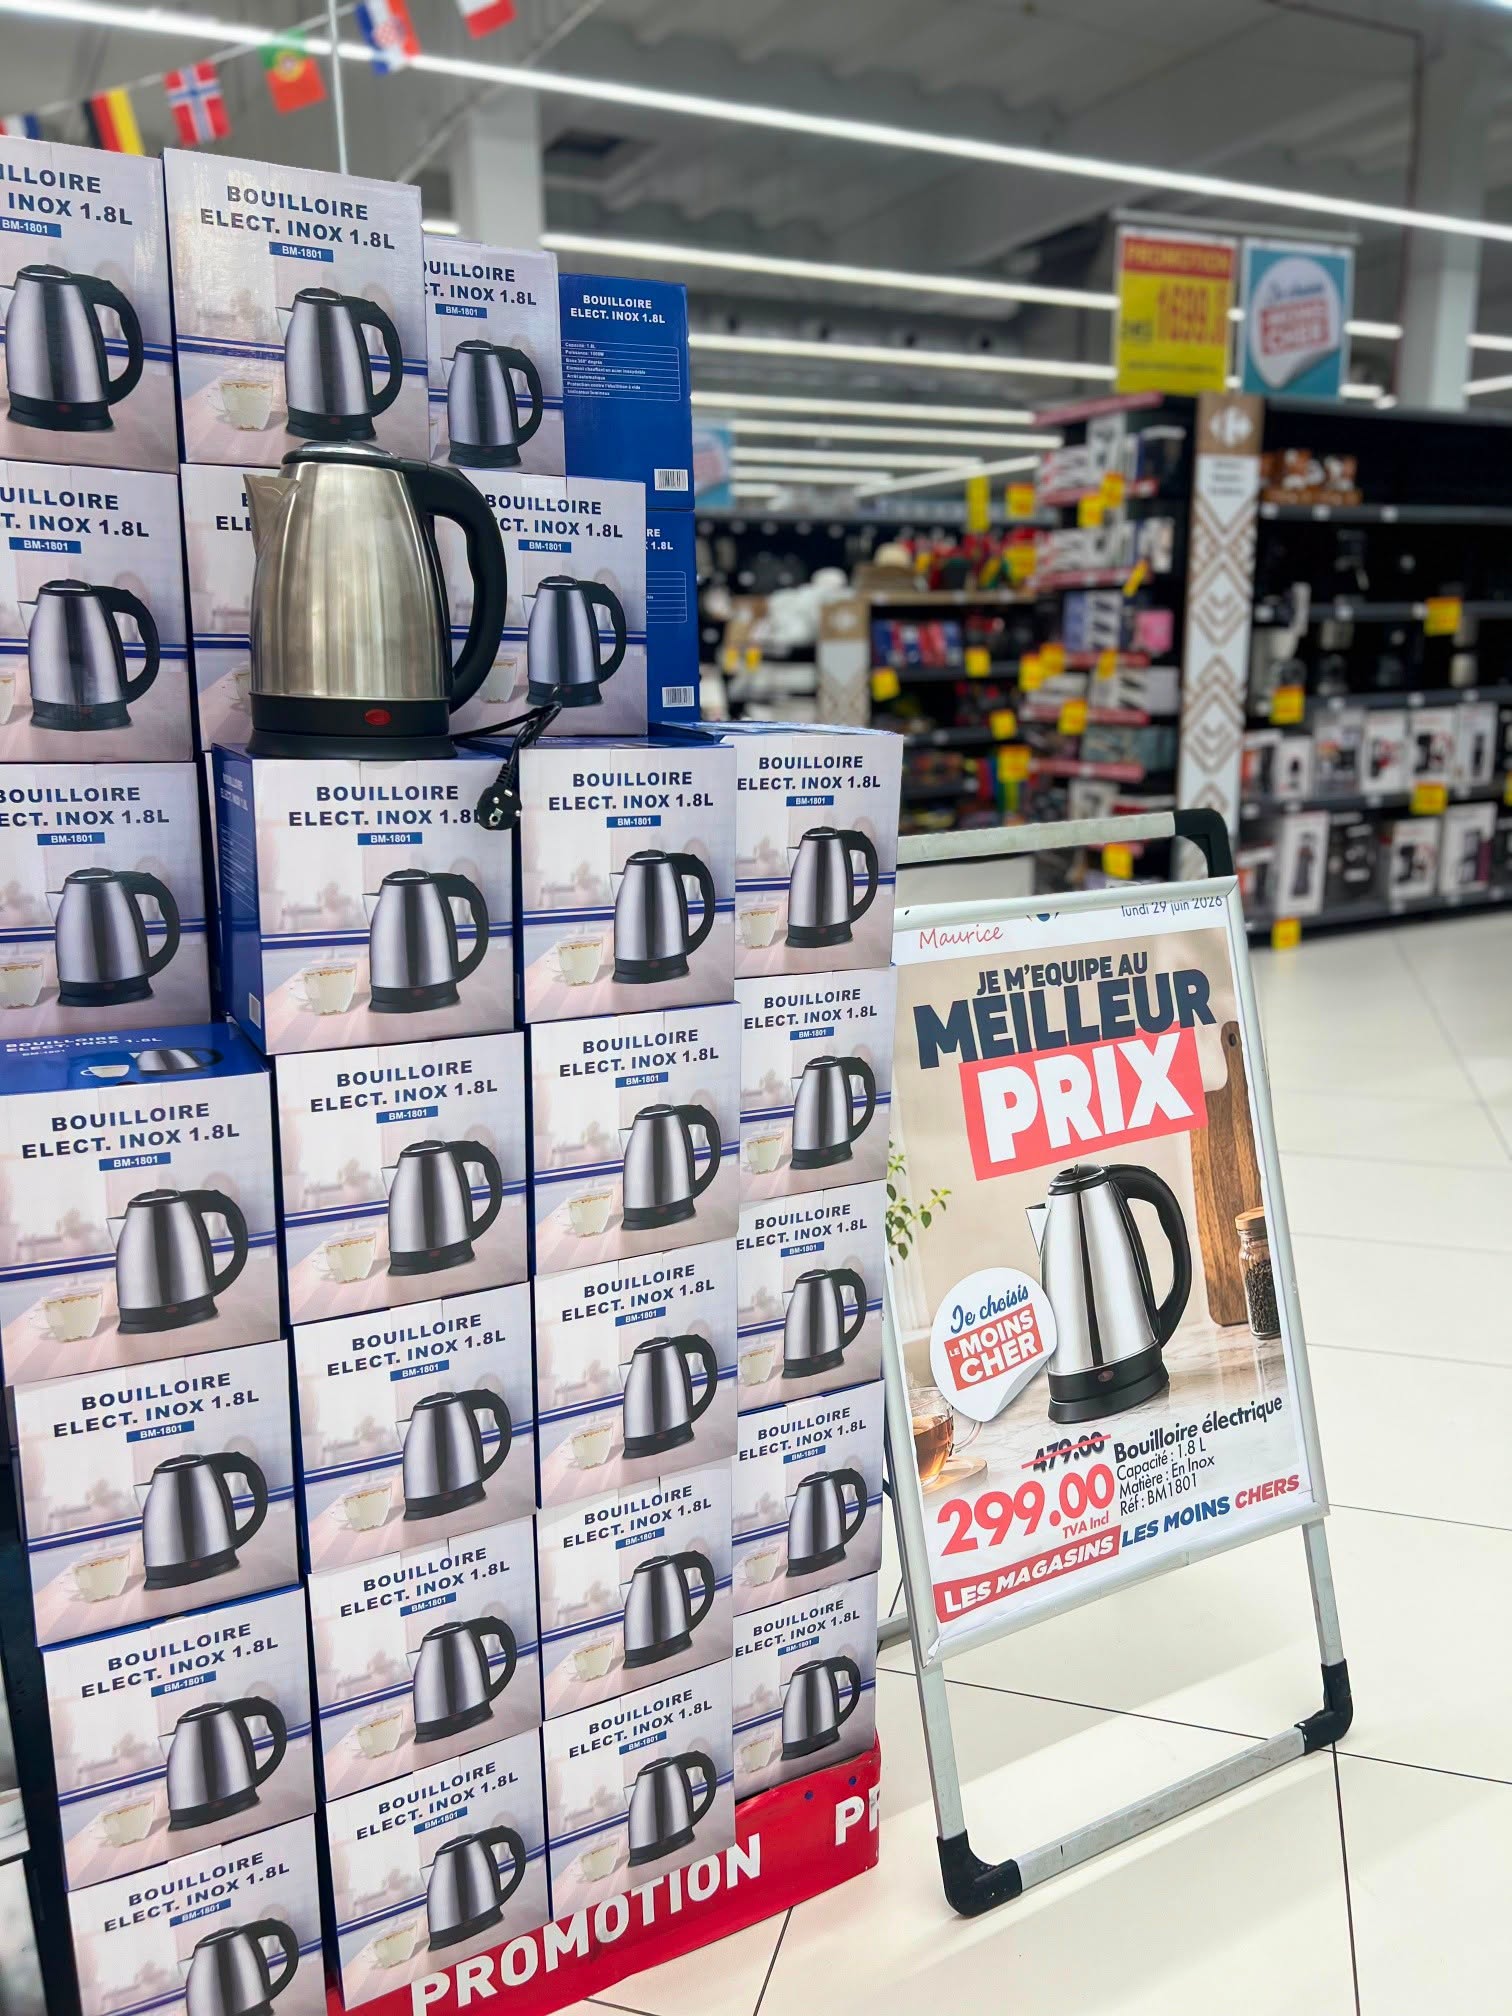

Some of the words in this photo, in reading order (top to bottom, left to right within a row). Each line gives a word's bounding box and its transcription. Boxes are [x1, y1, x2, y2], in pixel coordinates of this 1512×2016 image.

[9, 192, 72, 216] INOX
[80, 203, 132, 225] 1.8L
[228, 186, 368, 220] BOUILLOIRE
[2, 220, 47, 233] BM-1801
[201, 208, 280, 234] ELECT.
[288, 220, 342, 242] INOX
[350, 229, 394, 249] 1.8L
[282, 246, 321, 258] BM-1801
[424, 261, 515, 286] UILLOIRE
[450, 285, 494, 301] INOX
[500, 290, 536, 305] 1.8L
[583, 294, 652, 309] BOUILLOIRE
[570, 308, 609, 320] ELECT.
[612, 310, 639, 322] INOX
[642, 314, 665, 324] 1.8L
[0, 487, 118, 510] UILLOIRE
[486, 494, 601, 514] BOUILLOIRE
[30, 515, 91, 533] INOX
[99, 520, 149, 537] 1.8L
[535, 520, 579, 535] INOX
[586, 523, 622, 538] 1.8L
[24, 540, 68, 550] BM-1801
[529, 542, 561, 550] BM-1801
[651, 542, 673, 550] 1.8L
[574, 772, 692, 787] BOUILLOIRE
[759, 756, 863, 769] BOUILLOIRE
[317, 786, 458, 801] BOUILLOIRE
[738, 778, 795, 790] ELECT.
[802, 777, 842, 789] INOX
[848, 776, 880, 788] 1.8L
[56, 811, 114, 825] INOX
[122, 810, 169, 824] 1.8L
[289, 811, 368, 826] ELECT.
[378, 810, 432, 824] INOX
[549, 796, 616, 810] ELECT.
[624, 794, 669, 808] INOX
[676, 793, 713, 807] 1.8L
[371, 834, 410, 843] BM-1801
[618, 818, 650, 826] BM-1801
[919, 925, 1003, 949] Maurice
[976, 971, 1000, 995] JE
[1117, 952, 1148, 977] AU
[764, 989, 860, 1008] BOUILLOIRE
[744, 1014, 798, 1029] ELECT.
[804, 1009, 841, 1023] INOX
[847, 1006, 877, 1018] 1.8L
[913, 969, 1217, 1069] MEILLEUR
[584, 1029, 698, 1054] BOUILLOIRE
[337, 1060, 472, 1087] BOUILLOIRE
[560, 1059, 624, 1077] ELECT.
[632, 1052, 676, 1068] INOX
[683, 1048, 718, 1062] 1.8L
[311, 1092, 386, 1112] ELECT.
[395, 1085, 447, 1103] INOX
[455, 1080, 497, 1096] 1.8L
[977, 1032, 1194, 1163] PRIX
[52, 1103, 209, 1131] BOUILLOIRE
[22, 1137, 110, 1158] ELECT.
[120, 1130, 181, 1148] INOX
[190, 1124, 239, 1141] 1.8L
[756, 1204, 850, 1230] BOUILLOIRE
[736, 1232, 789, 1250] ELECT.
[795, 1224, 831, 1240] INOX
[837, 1219, 867, 1232] 1.8L
[584, 1264, 694, 1298] BOUILLOIRE
[562, 1299, 624, 1322] ELECT.
[631, 1288, 674, 1307] INOX
[680, 1280, 714, 1296] 1.8L
[951, 1305, 975, 1334] Je
[980, 1284, 1028, 1319] choisis
[352, 1314, 481, 1351] BOUILLOIRE
[949, 1347, 960, 1357] LE
[958, 1309, 1033, 1359] MOINS
[328, 1352, 400, 1376] ELECT.
[408, 1339, 458, 1360] INOX
[465, 1330, 505, 1348] 1.8L
[959, 1331, 1037, 1383] CHER
[82, 1373, 230, 1410] BOUILLOIRE
[54, 1412, 137, 1437] ELECT.
[146, 1399, 204, 1421] INOX
[212, 1390, 259, 1408] 1.8L
[758, 1407, 850, 1440] BOUILLOIRE
[1114, 1422, 1198, 1464] Bouilloire
[1201, 1396, 1283, 1434] électrique
[740, 1440, 791, 1461] ELECT.
[797, 1428, 832, 1446] INOX
[838, 1420, 866, 1435] 1.8L
[1033, 1431, 1105, 1473] 479.00
[1117, 1449, 1168, 1481] Capacité
[1178, 1440, 1195, 1458] 1.8
[1200, 1437, 1206, 1452] L
[1119, 1474, 1163, 1500] Matière
[1171, 1462, 1185, 1479] En
[1188, 1456, 1215, 1473] Inox
[1147, 1473, 1197, 1506] BM1801
[585, 1485, 692, 1525] BOUILLOIRE
[937, 1463, 1115, 1557] 299.00
[1122, 1520, 1158, 1549] LES
[1163, 1495, 1231, 1534] MOINS
[1235, 1474, 1300, 1510] CHERS
[564, 1524, 624, 1548] ELECT.
[631, 1509, 672, 1530] INOX
[678, 1498, 711, 1516] 1.8L
[1063, 1523, 1086, 1540] TVA
[1088, 1512, 1109, 1533] Incl
[364, 1548, 486, 1592] BOUILLOIRE
[944, 1580, 991, 1613] LES
[995, 1534, 1114, 1594] MAGASINS
[341, 1590, 409, 1617] ELECT.
[417, 1573, 464, 1596] INOX
[471, 1561, 510, 1580] 1.8L
[736, 1634, 785, 1657] ELECT.
[791, 1620, 826, 1639] INOX
[831, 1611, 860, 1626] 1.8L
[754, 1600, 843, 1636] BOUILLOIRE
[108, 1624, 250, 1671] BOUILLOIRE
[82, 1668, 161, 1698] ELECT.
[170, 1650, 225, 1675] INOX
[233, 1638, 278, 1657] 1.8L
[590, 1690, 692, 1734] BOUILLOIRE
[570, 1730, 627, 1758] ELECT.
[634, 1713, 673, 1736] INOX
[679, 1701, 712, 1718] 1.8L
[379, 1762, 495, 1814] BOUILLOIRE
[357, 1808, 422, 1840] ELECT.
[430, 1787, 474, 1813] INOX
[481, 1772, 518, 1793] 1.8L
[129, 1852, 263, 1906] BOUILLOIRE
[104, 1900, 179, 1932] ELECT.
[187, 1879, 239, 1906] INOX
[246, 1863, 289, 1884] 1.8L
[411, 1833, 761, 2016] PROMOTION
